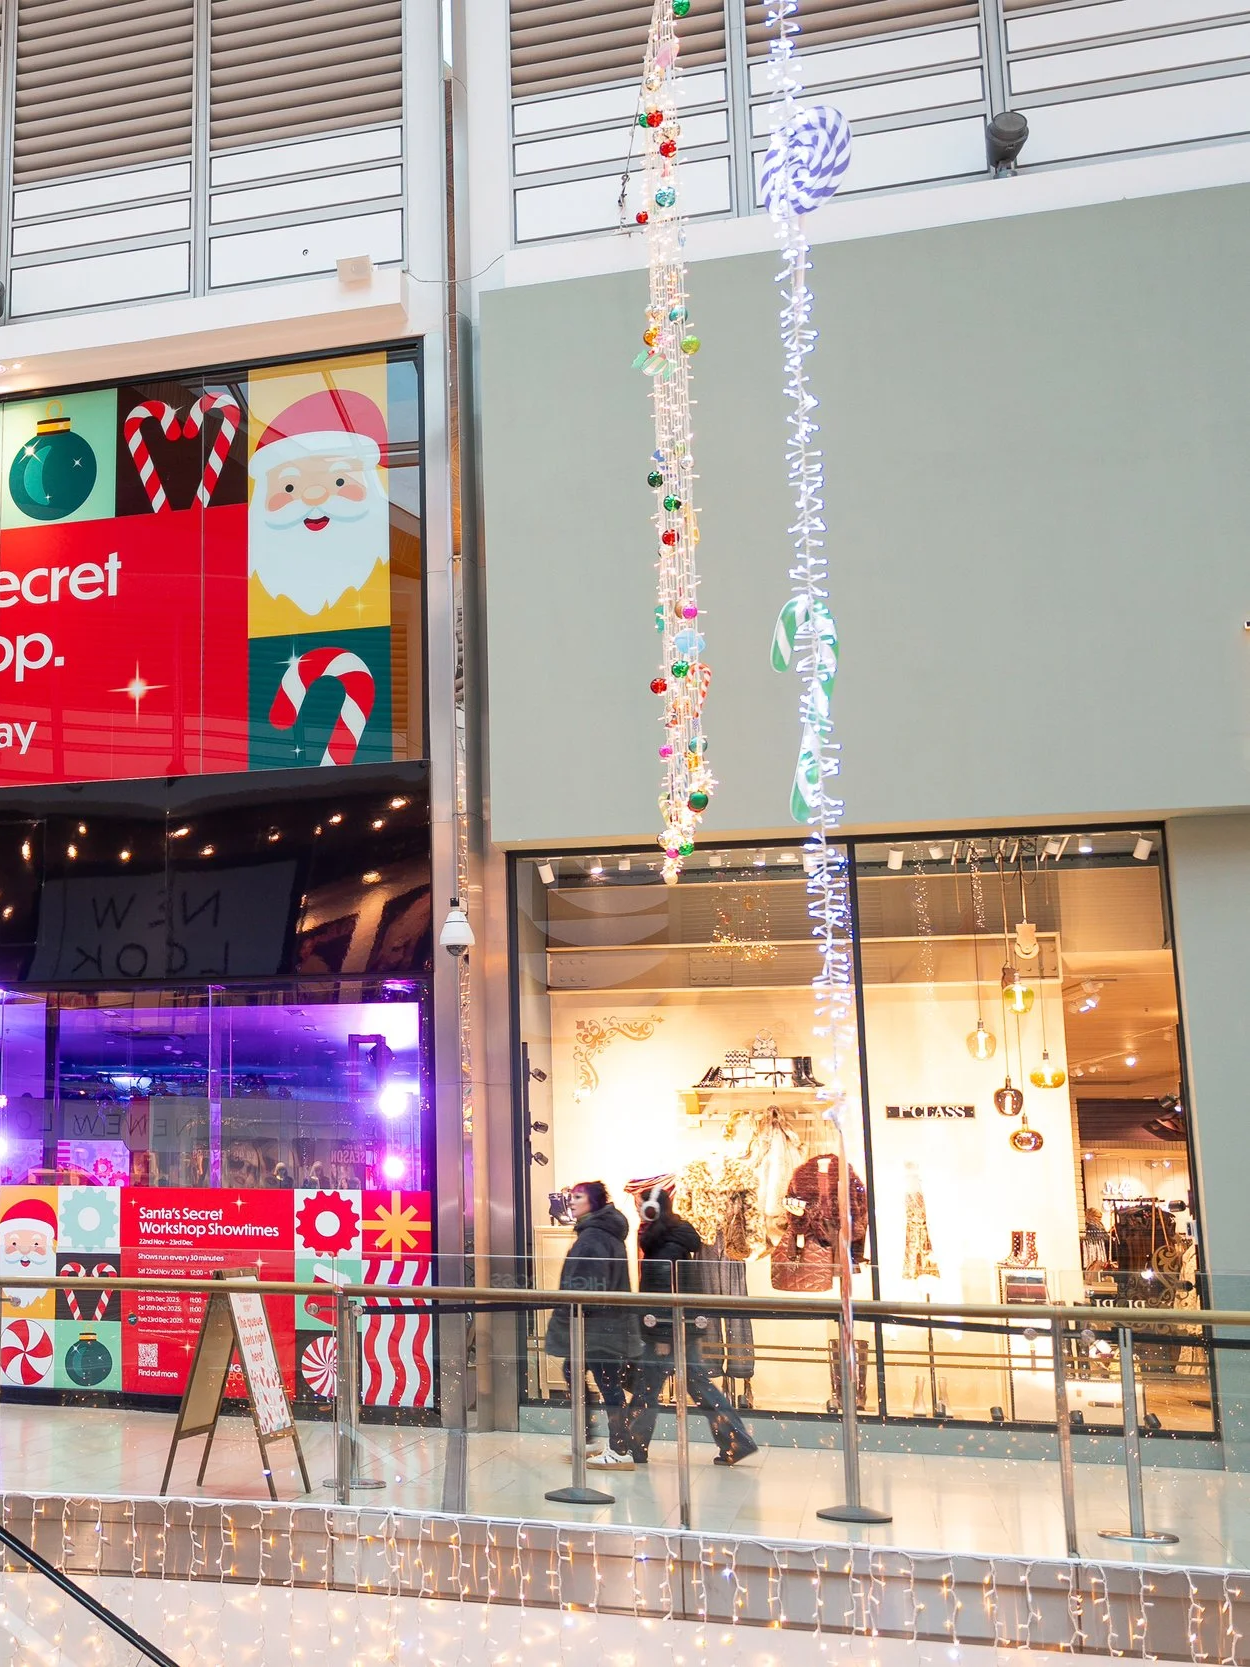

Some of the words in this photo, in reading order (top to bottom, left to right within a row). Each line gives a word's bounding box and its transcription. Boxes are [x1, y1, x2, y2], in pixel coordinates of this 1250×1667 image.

[911, 1105, 965, 1119] CLASS
[139, 1206, 181, 1220] Santa's
[182, 1207, 223, 1220] Secret
[139, 1221, 206, 1238] Workshop
[208, 1223, 279, 1237] Showtimes
[138, 1238, 153, 1246] 22nd
[137, 1252, 158, 1260] Shows
[169, 1255, 190, 1263] every
[137, 1267, 145, 1275] Sat
[159, 1316, 169, 1324] Dec
[138, 1368, 150, 1377] Find
